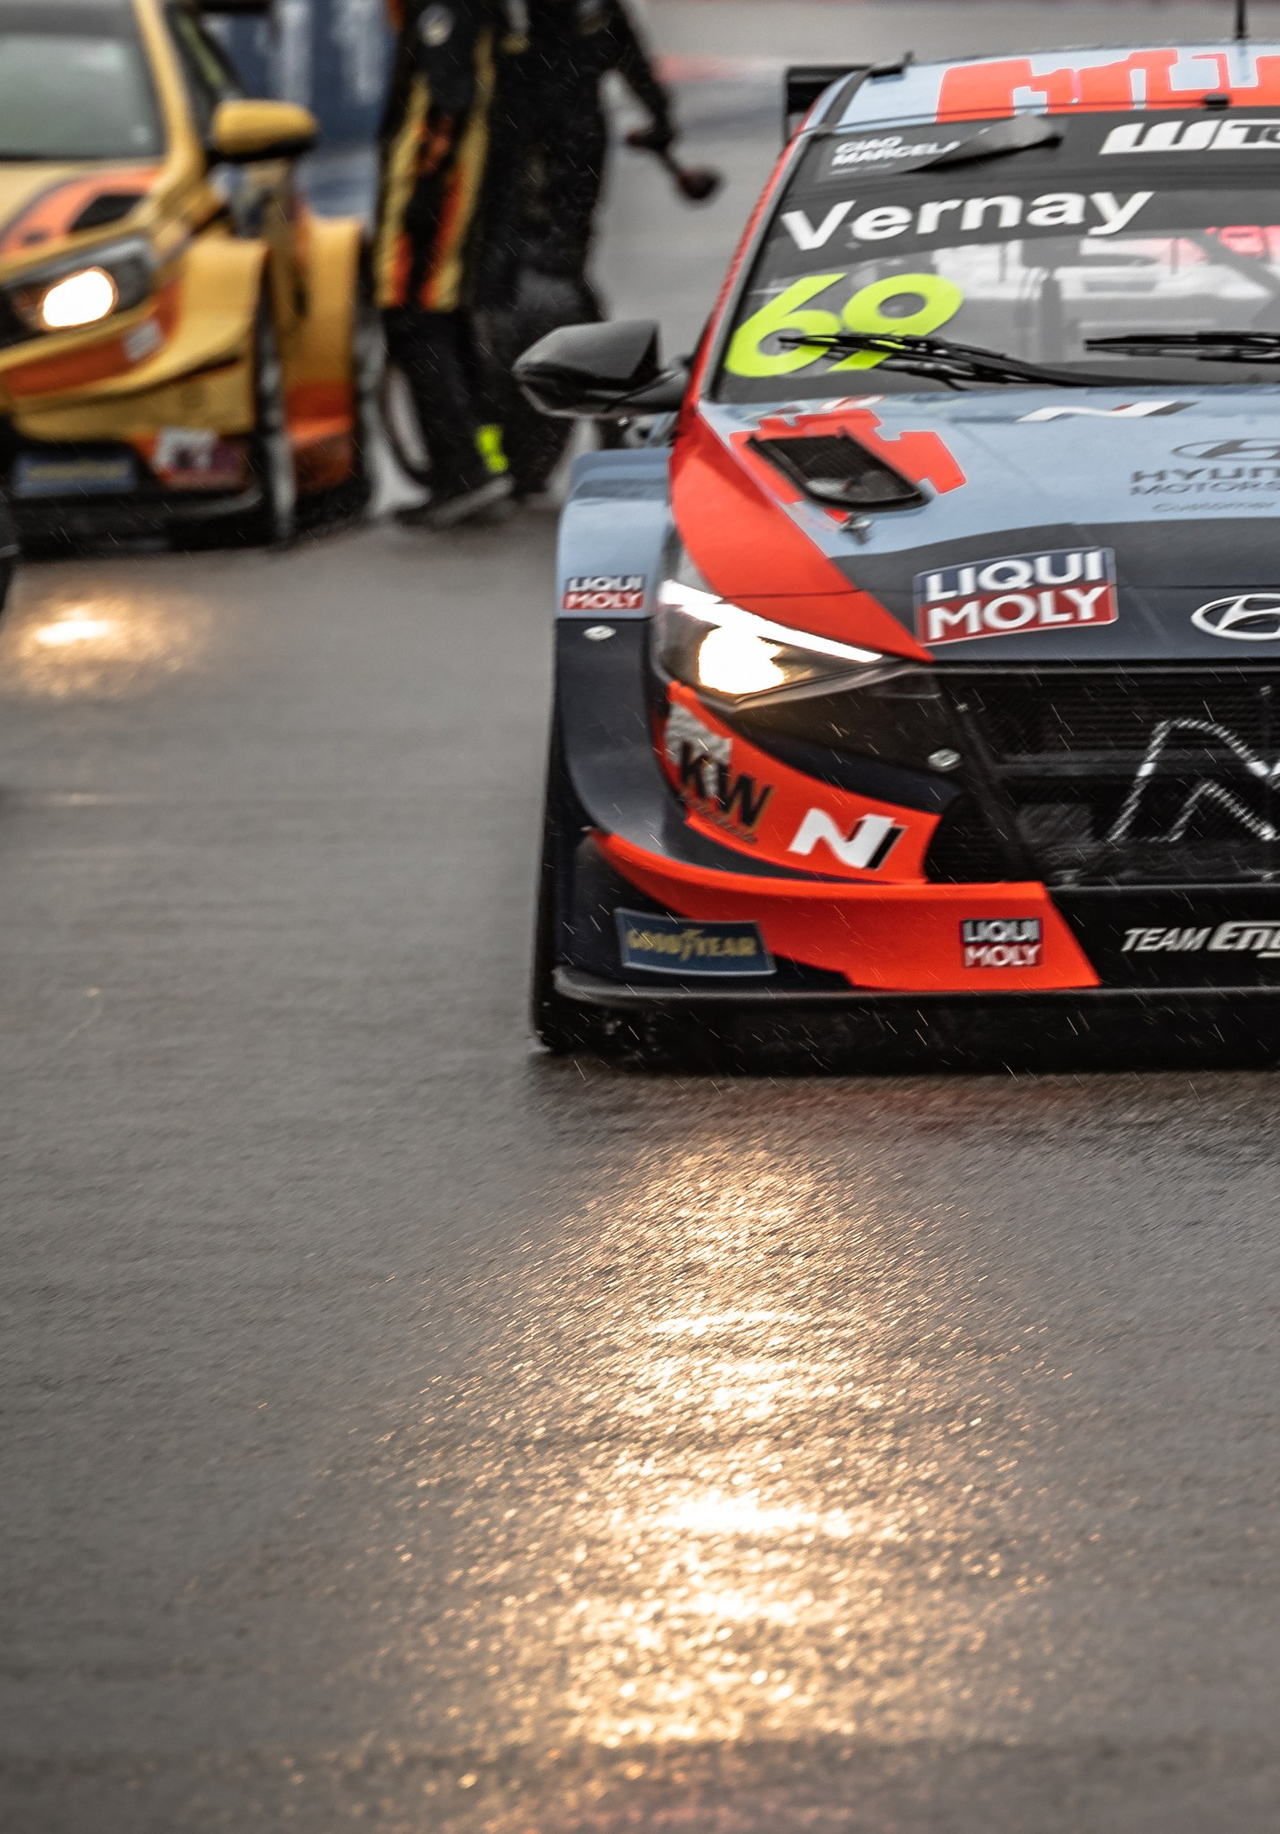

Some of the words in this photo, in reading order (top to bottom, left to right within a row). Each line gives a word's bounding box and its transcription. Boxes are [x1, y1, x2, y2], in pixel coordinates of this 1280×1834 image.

[782, 191, 1154, 251] Vernay
[724, 273, 963, 378] 69
[927, 549, 1102, 602] LIQUI
[929, 586, 1107, 640] MOLY
[680, 740, 774, 828] KW
[963, 920, 1039, 943] LIQUI
[964, 944, 1042, 966] MOLY
[1121, 927, 1212, 952] TEAM
